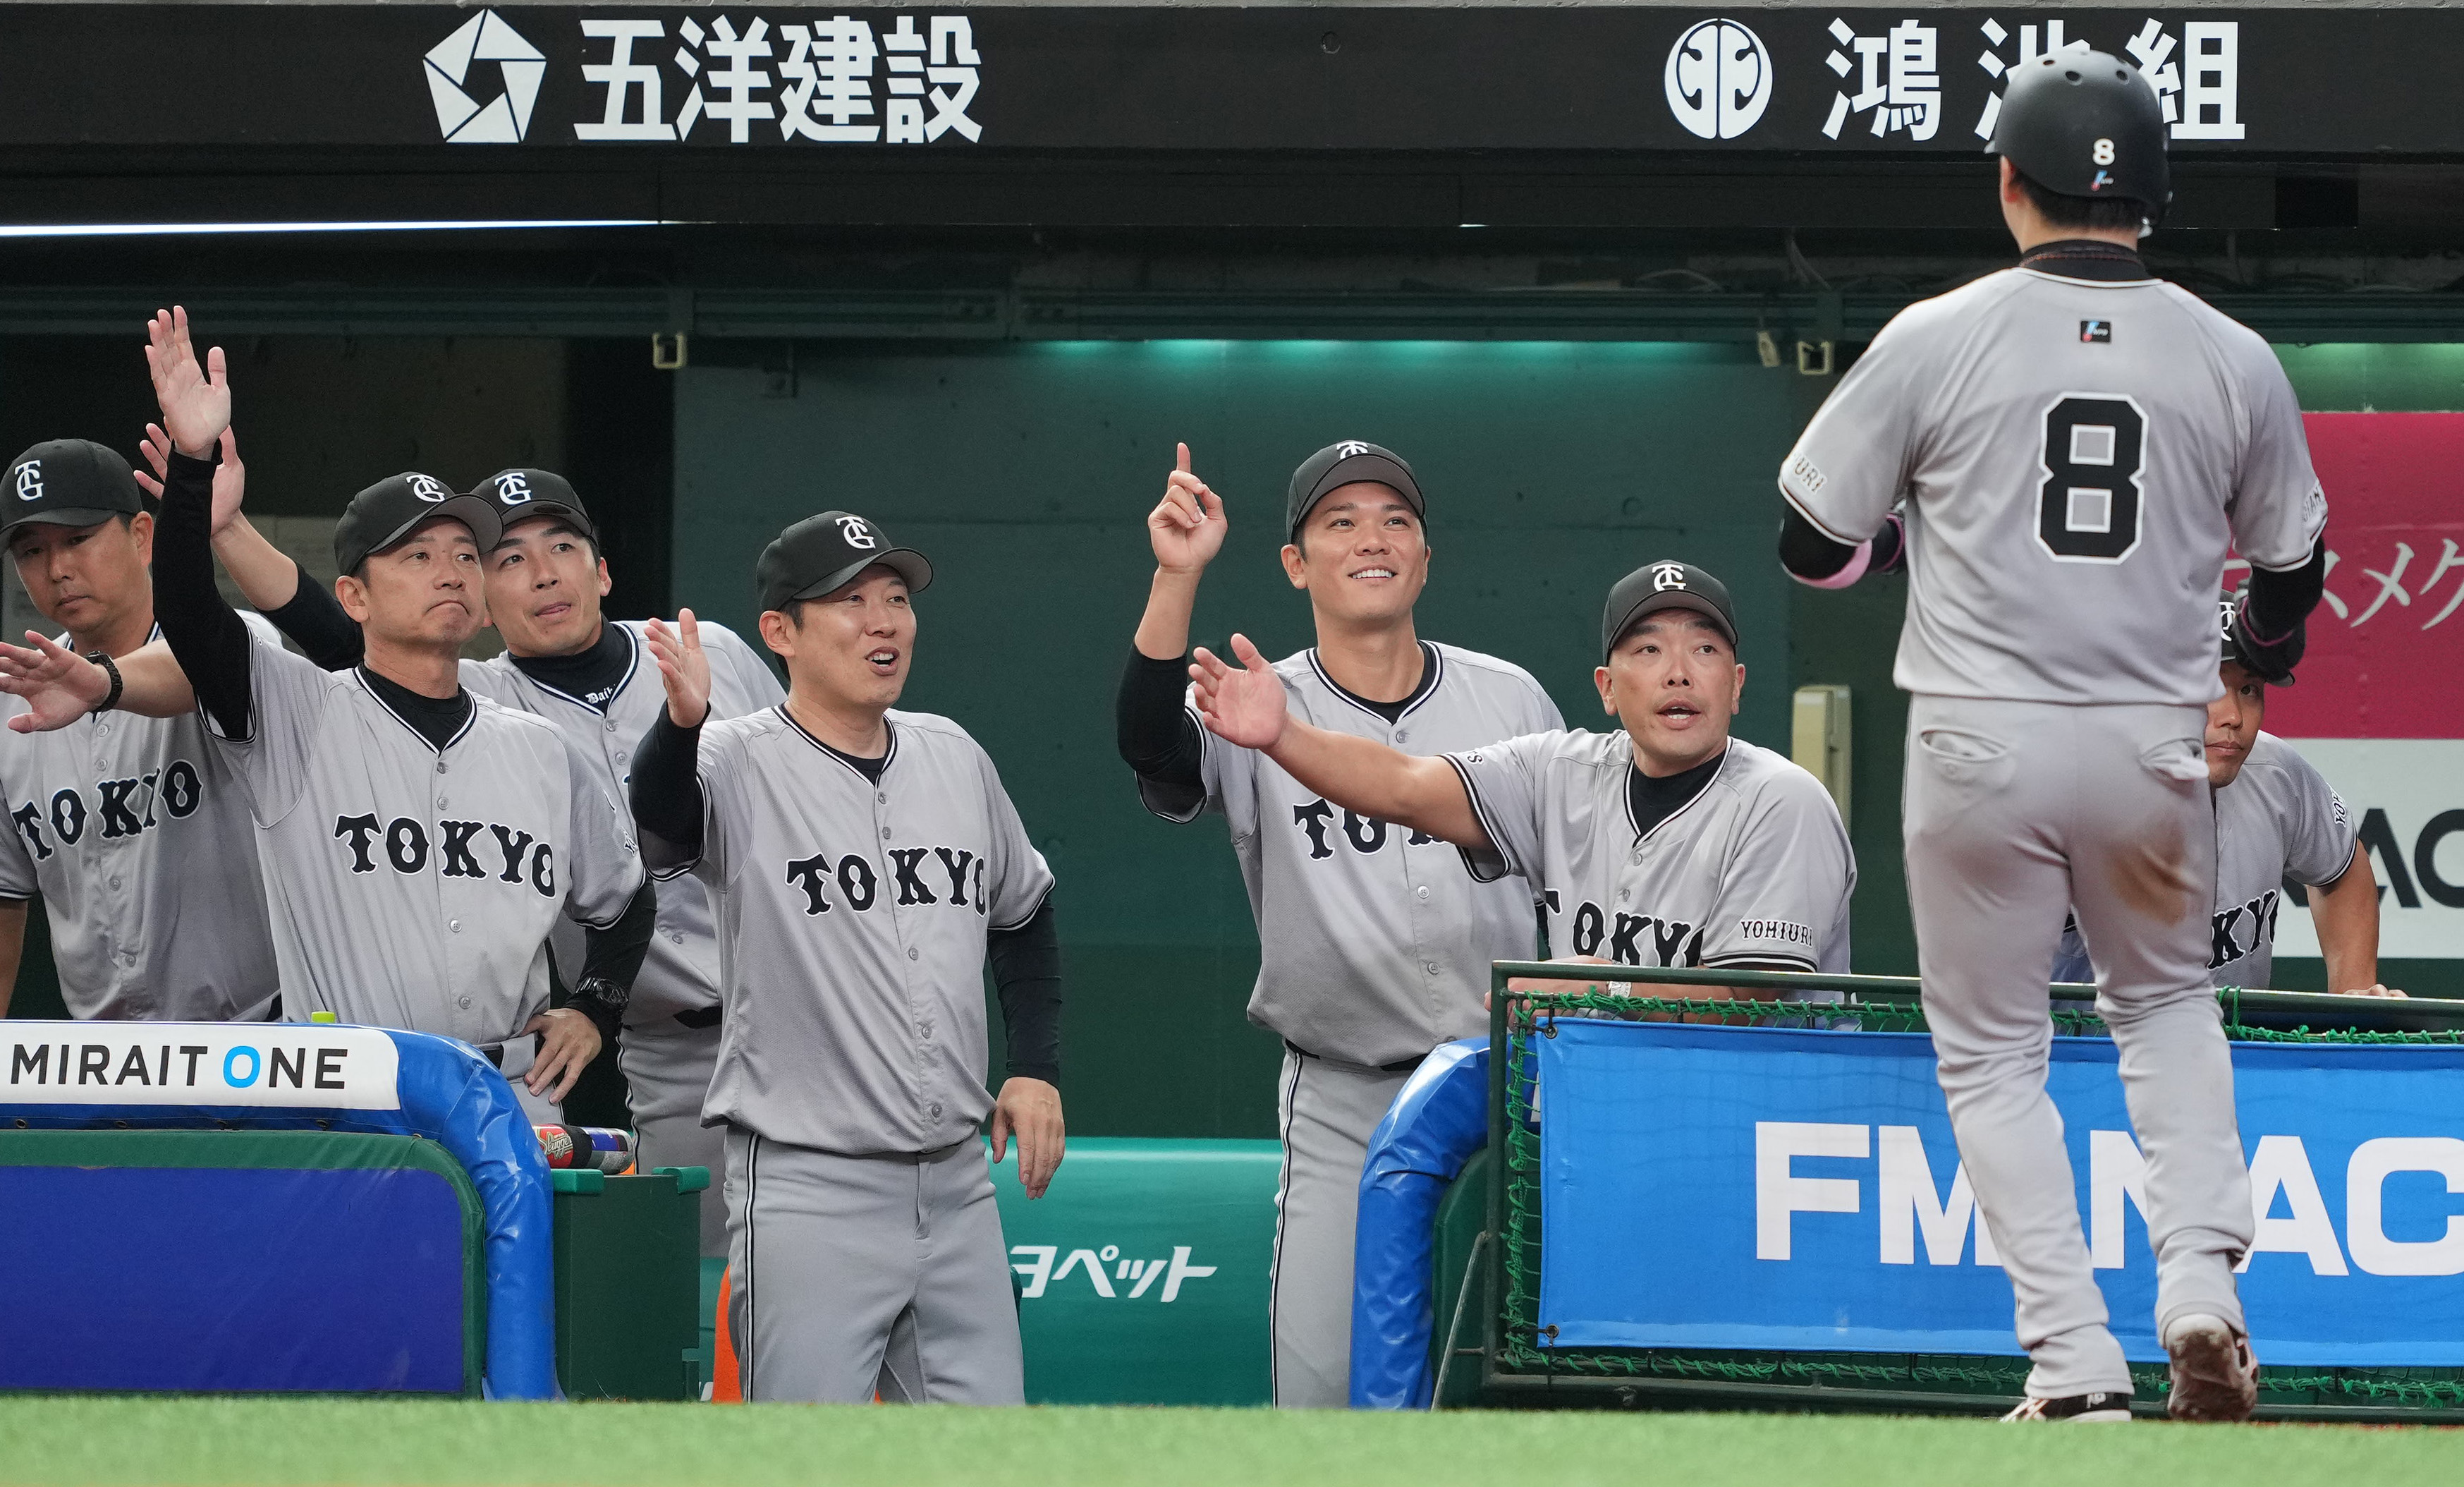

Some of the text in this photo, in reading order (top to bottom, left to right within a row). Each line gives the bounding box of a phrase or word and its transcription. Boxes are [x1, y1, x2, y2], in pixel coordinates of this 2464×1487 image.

[573, 16, 982, 143] 五洋建設
[2092, 138, 2115, 166] 8
[1793, 453, 1828, 495] URI
[2034, 392, 2149, 565] 8
[11, 759, 204, 862] TOKYO
[333, 811, 556, 899] TOKYO
[784, 846, 987, 918] TOKYO
[1740, 918, 1813, 949] YOHIURI
[10, 1043, 348, 1090] MIRAIT ONE
[1755, 1121, 2008, 1268] FM
[1010, 1244, 1218, 1303] ヨペット
